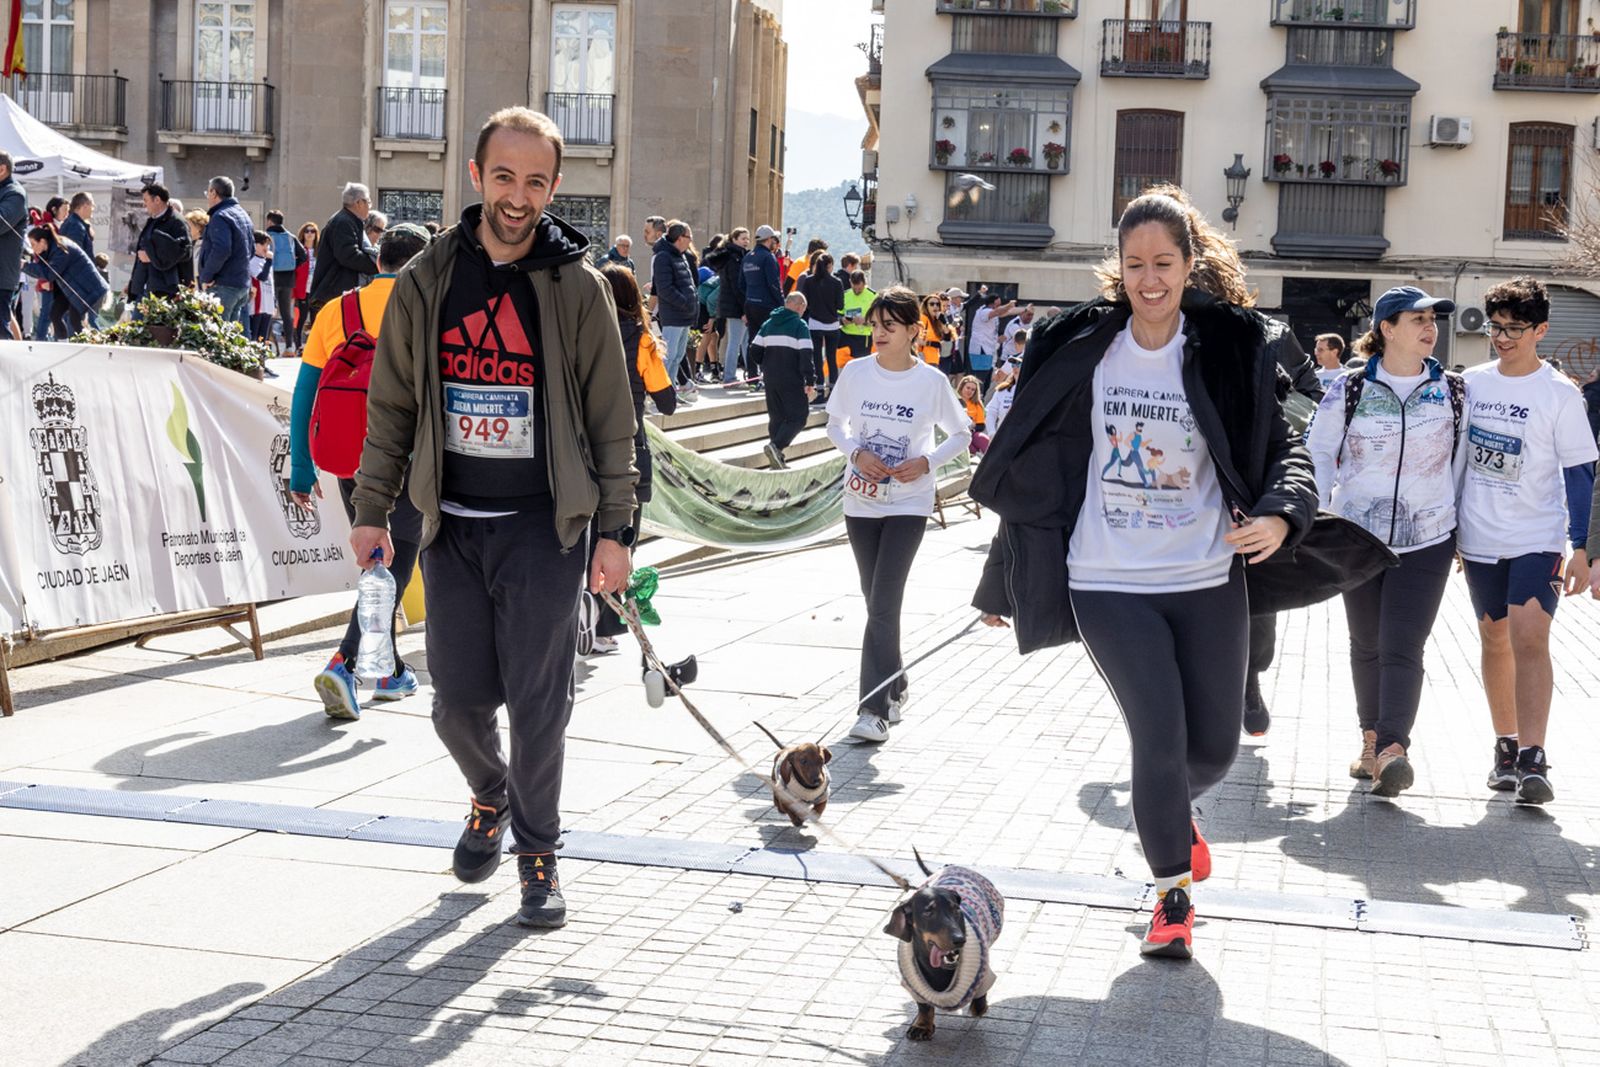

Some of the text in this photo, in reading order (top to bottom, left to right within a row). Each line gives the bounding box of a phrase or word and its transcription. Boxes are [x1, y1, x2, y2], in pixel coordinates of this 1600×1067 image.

[440, 348, 535, 386] adidas
[484, 393, 519, 402] CAMINATA
[1106, 386, 1188, 403] CARRERA CAMIN
[472, 402, 504, 414] MUERTE
[861, 400, 914, 418] Kairós '26
[1131, 402, 1180, 423] MUERTE
[1473, 400, 1529, 419] Kairós '26
[459, 415, 510, 443] 949
[1474, 446, 1505, 469] 373
[161, 531, 199, 548] Patronato
[200, 528, 238, 546] Municipal
[175, 550, 212, 568] Deportes
[272, 544, 345, 566] CIUDAD DE JAÉN
[37, 559, 130, 589] CIUDAD DE JAÉN
